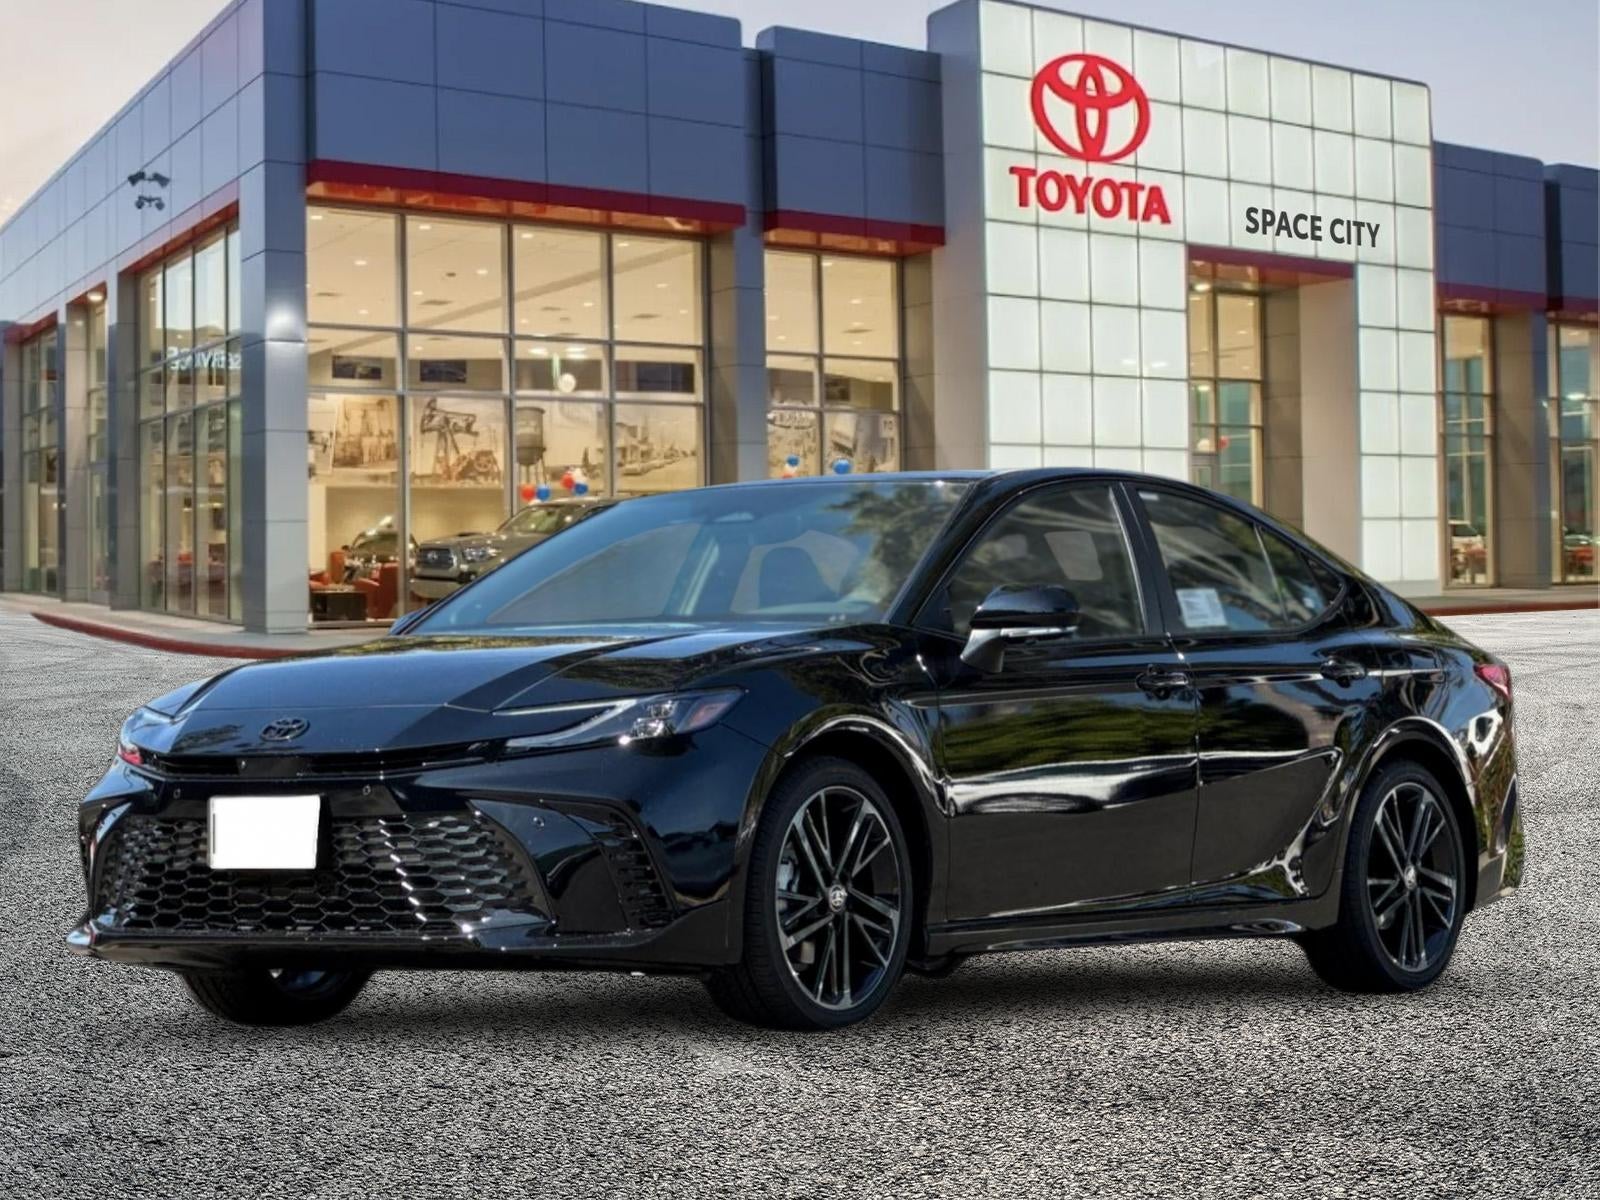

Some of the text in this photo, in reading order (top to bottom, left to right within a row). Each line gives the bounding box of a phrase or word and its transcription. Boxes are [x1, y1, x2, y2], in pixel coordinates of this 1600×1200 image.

[1009, 165, 1171, 224] TOYOTA
[1245, 206, 1381, 248] SPACE CITY
